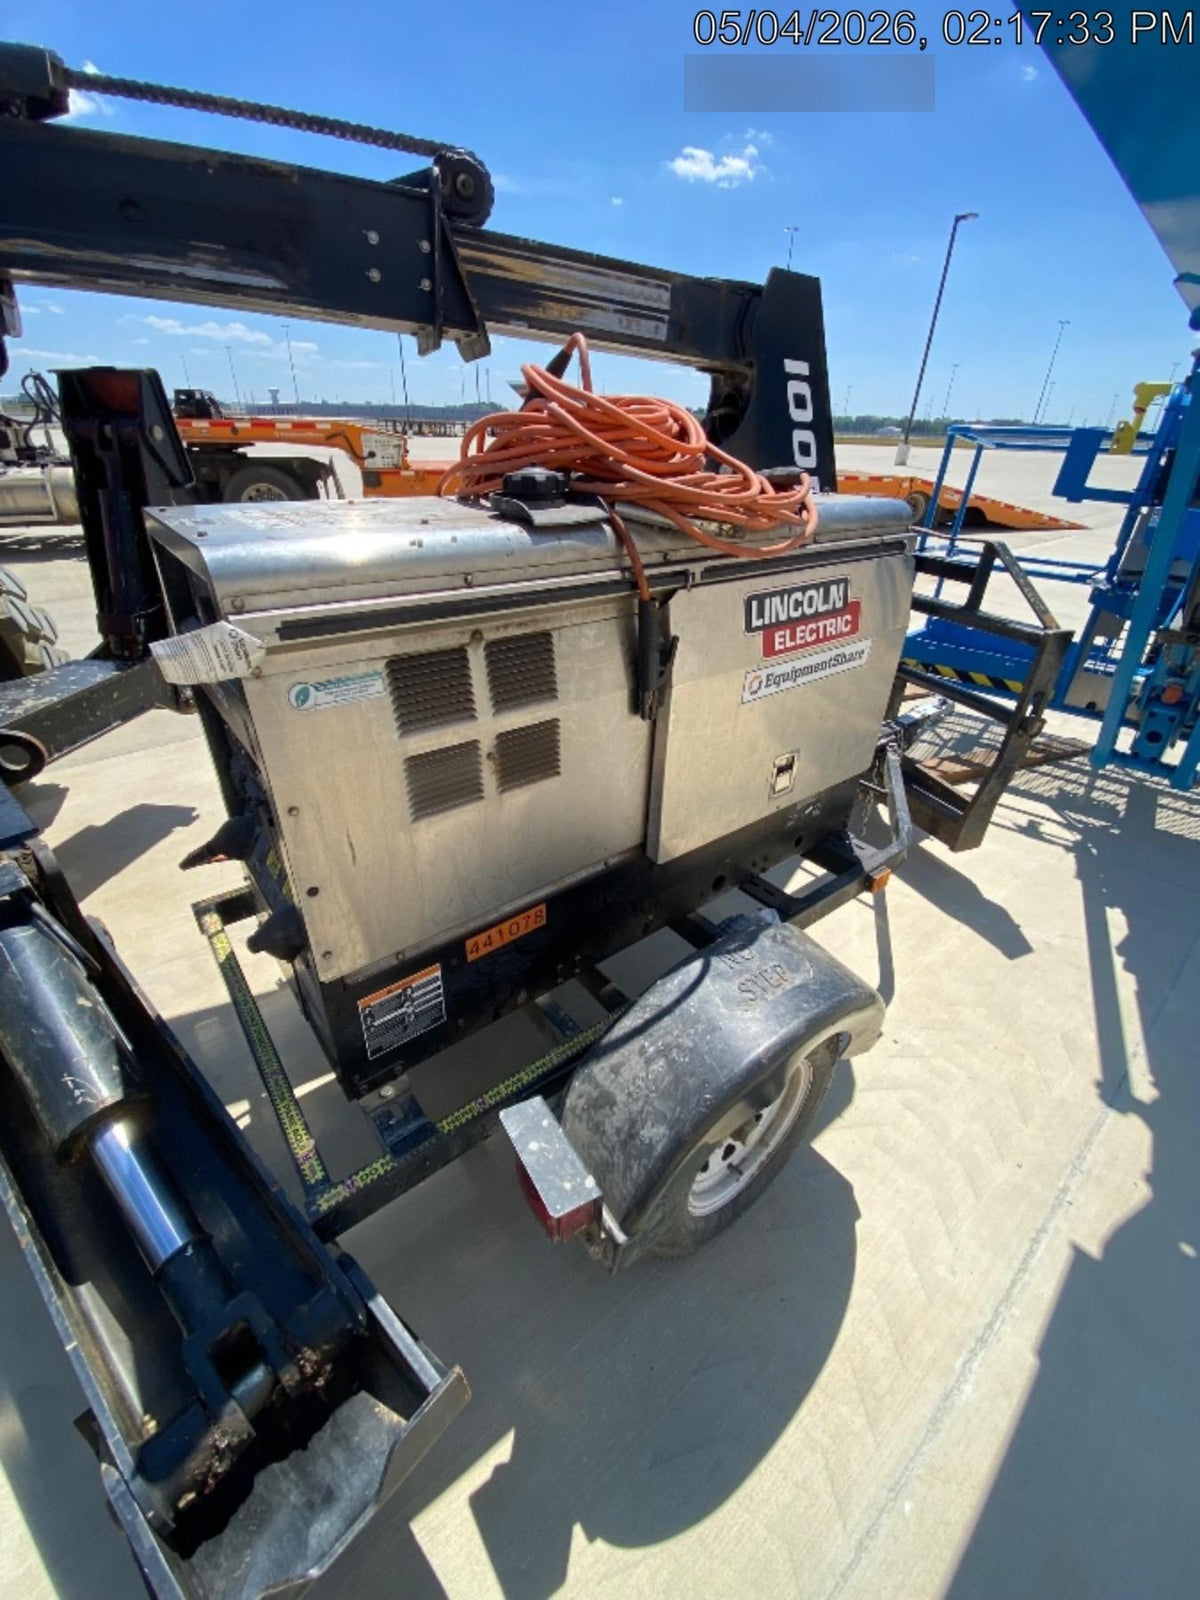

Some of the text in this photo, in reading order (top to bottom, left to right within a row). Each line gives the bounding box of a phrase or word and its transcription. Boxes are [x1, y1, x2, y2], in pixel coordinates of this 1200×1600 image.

[750, 582, 846, 629] LINCOLN
[773, 614, 853, 652] ELECTRIC
[763, 648, 865, 689] EquipmentShare
[467, 908, 546, 957] 441078
[736, 961, 790, 1003] STEP
